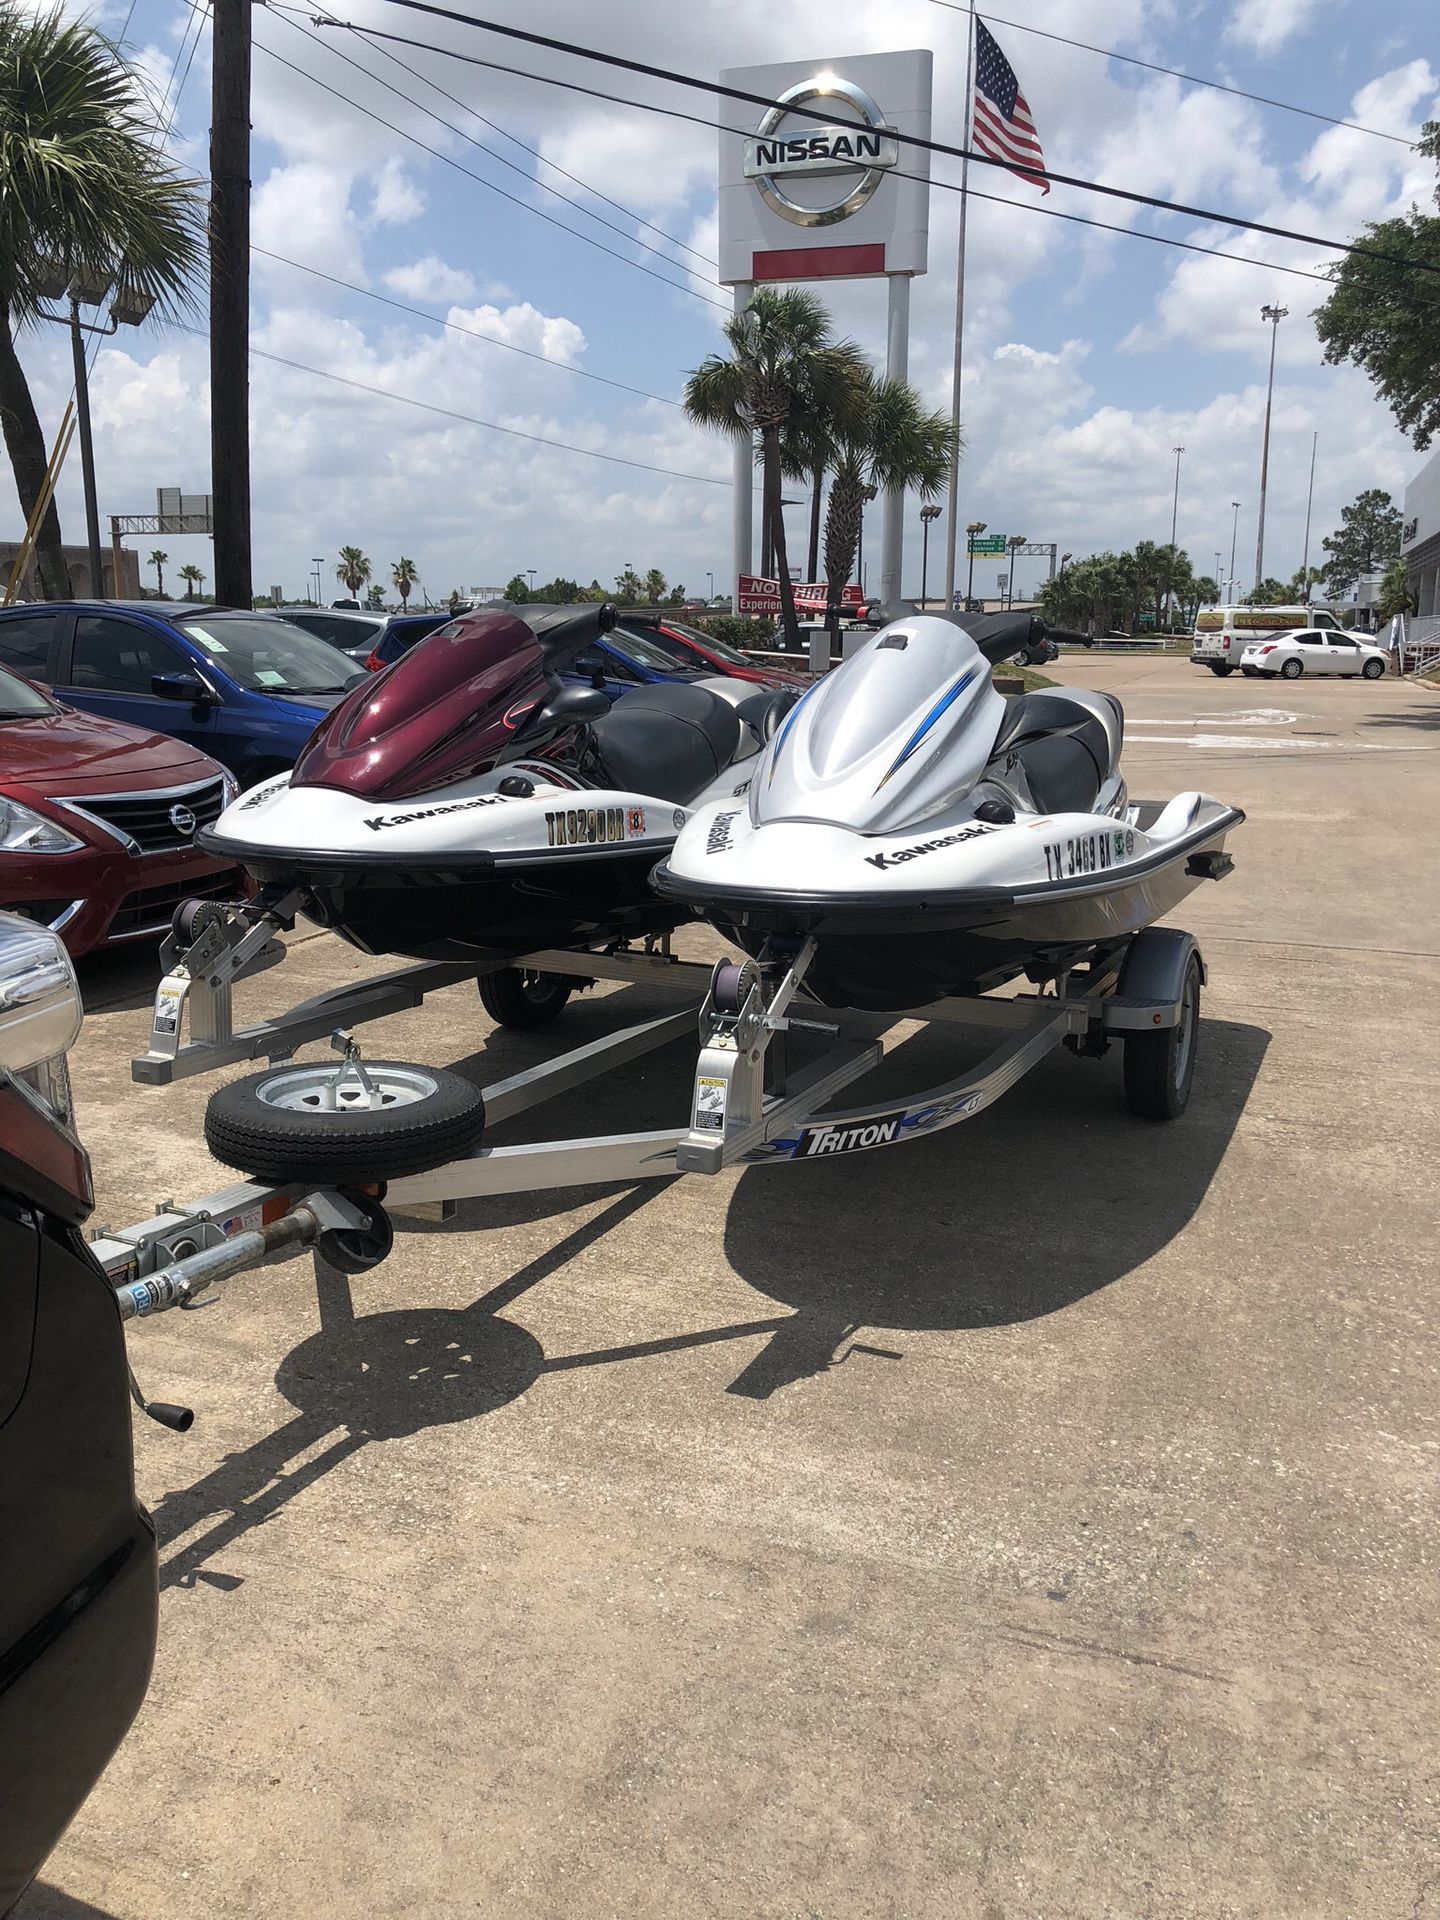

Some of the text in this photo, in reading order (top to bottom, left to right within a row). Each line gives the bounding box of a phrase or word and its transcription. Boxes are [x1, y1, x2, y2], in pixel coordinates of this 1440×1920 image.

[757, 135, 880, 166] NISSAN
[740, 598, 783, 611] Experien
[794, 586, 851, 601] HIRIG
[362, 795, 508, 831] Kawasaki
[706, 809, 744, 855] Kawasaki
[863, 823, 1002, 871] Kawasaki
[1044, 844, 1064, 881] TX
[806, 1120, 898, 1156] TRITON
